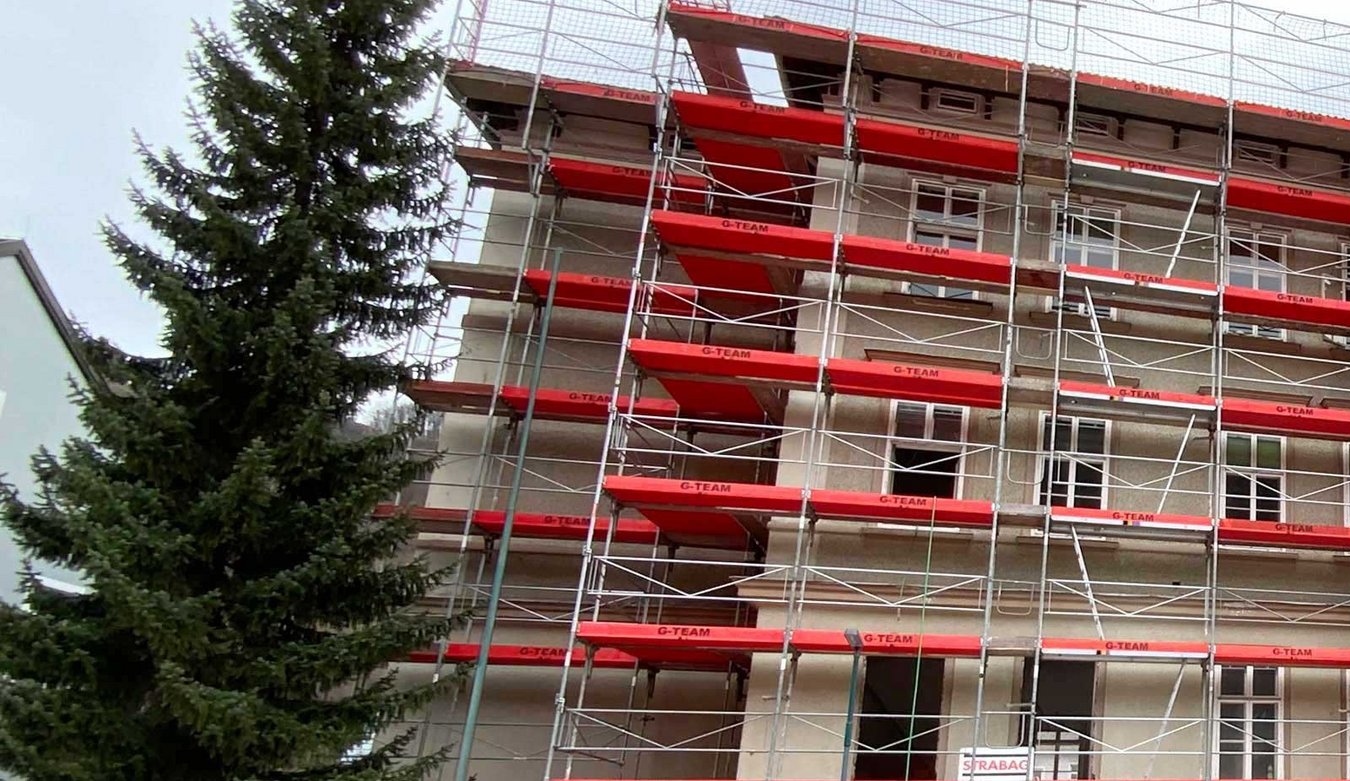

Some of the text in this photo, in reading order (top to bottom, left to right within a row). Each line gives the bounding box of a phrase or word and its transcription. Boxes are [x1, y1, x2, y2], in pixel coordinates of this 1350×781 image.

[918, 128, 960, 141] G-TEAM
[1277, 186, 1313, 197] G-TEAM
[722, 220, 769, 233] G-TEAM
[906, 243, 950, 256] G-TEAM
[1124, 273, 1163, 283] G-TEAM
[1277, 294, 1312, 303] G-TEAM
[702, 346, 751, 359] G-TEAM
[894, 366, 939, 378] G-TEAM
[1120, 389, 1160, 399] G-TEAM
[1277, 406, 1313, 416] G-TEAM
[680, 482, 731, 493] G-TEAM
[879, 495, 926, 506] G-TEAM
[1112, 512, 1154, 522] G-TEAM
[1275, 523, 1313, 533] G-TEAM
[658, 627, 710, 637] G-TEAM
[864, 634, 913, 644] G-TEAM
[1105, 641, 1148, 651] G-TEAM
[1272, 648, 1312, 657] G-TEAM
[963, 760, 1028, 771] STRABAG
